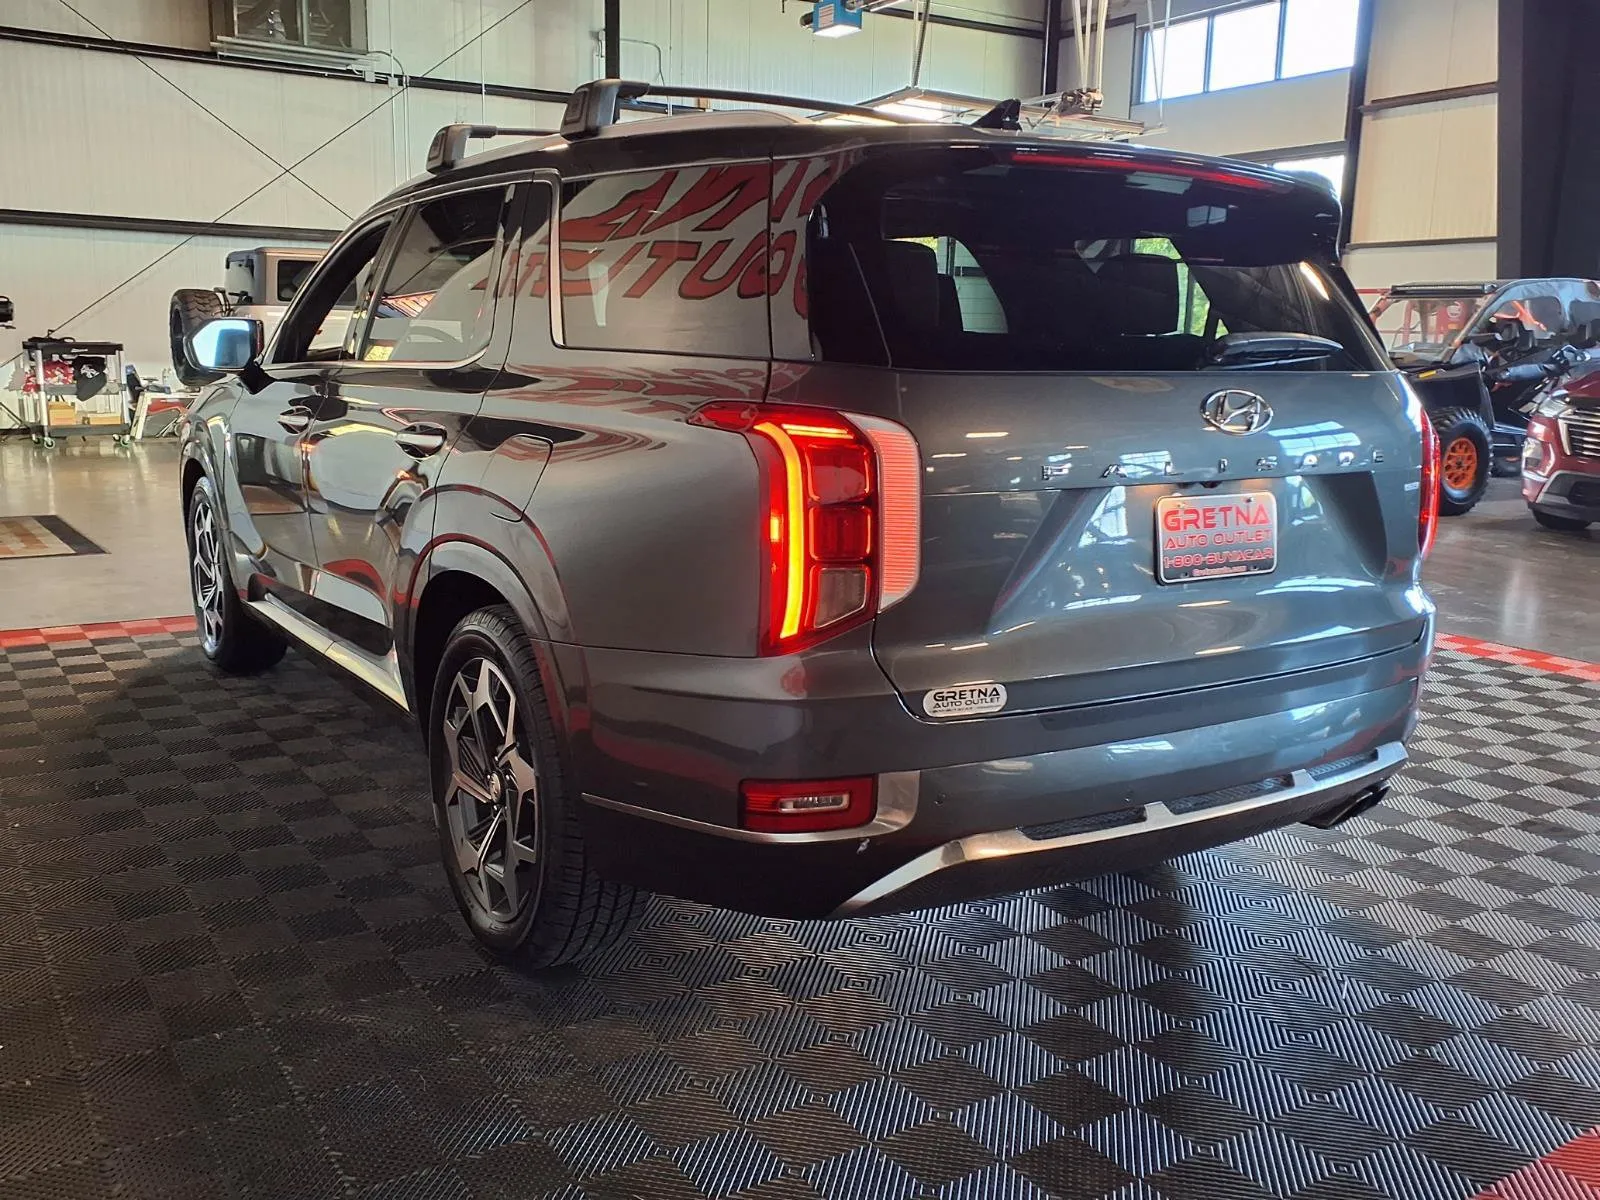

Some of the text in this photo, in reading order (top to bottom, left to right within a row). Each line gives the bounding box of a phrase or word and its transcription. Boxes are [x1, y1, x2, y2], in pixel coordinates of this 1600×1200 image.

[1163, 503, 1271, 532] GRETNA
[1165, 529, 1272, 550] AUTO OUTLET
[933, 687, 1000, 702] GRETNA
[933, 700, 962, 709] AUTO
[964, 696, 1001, 706] OUTLET
